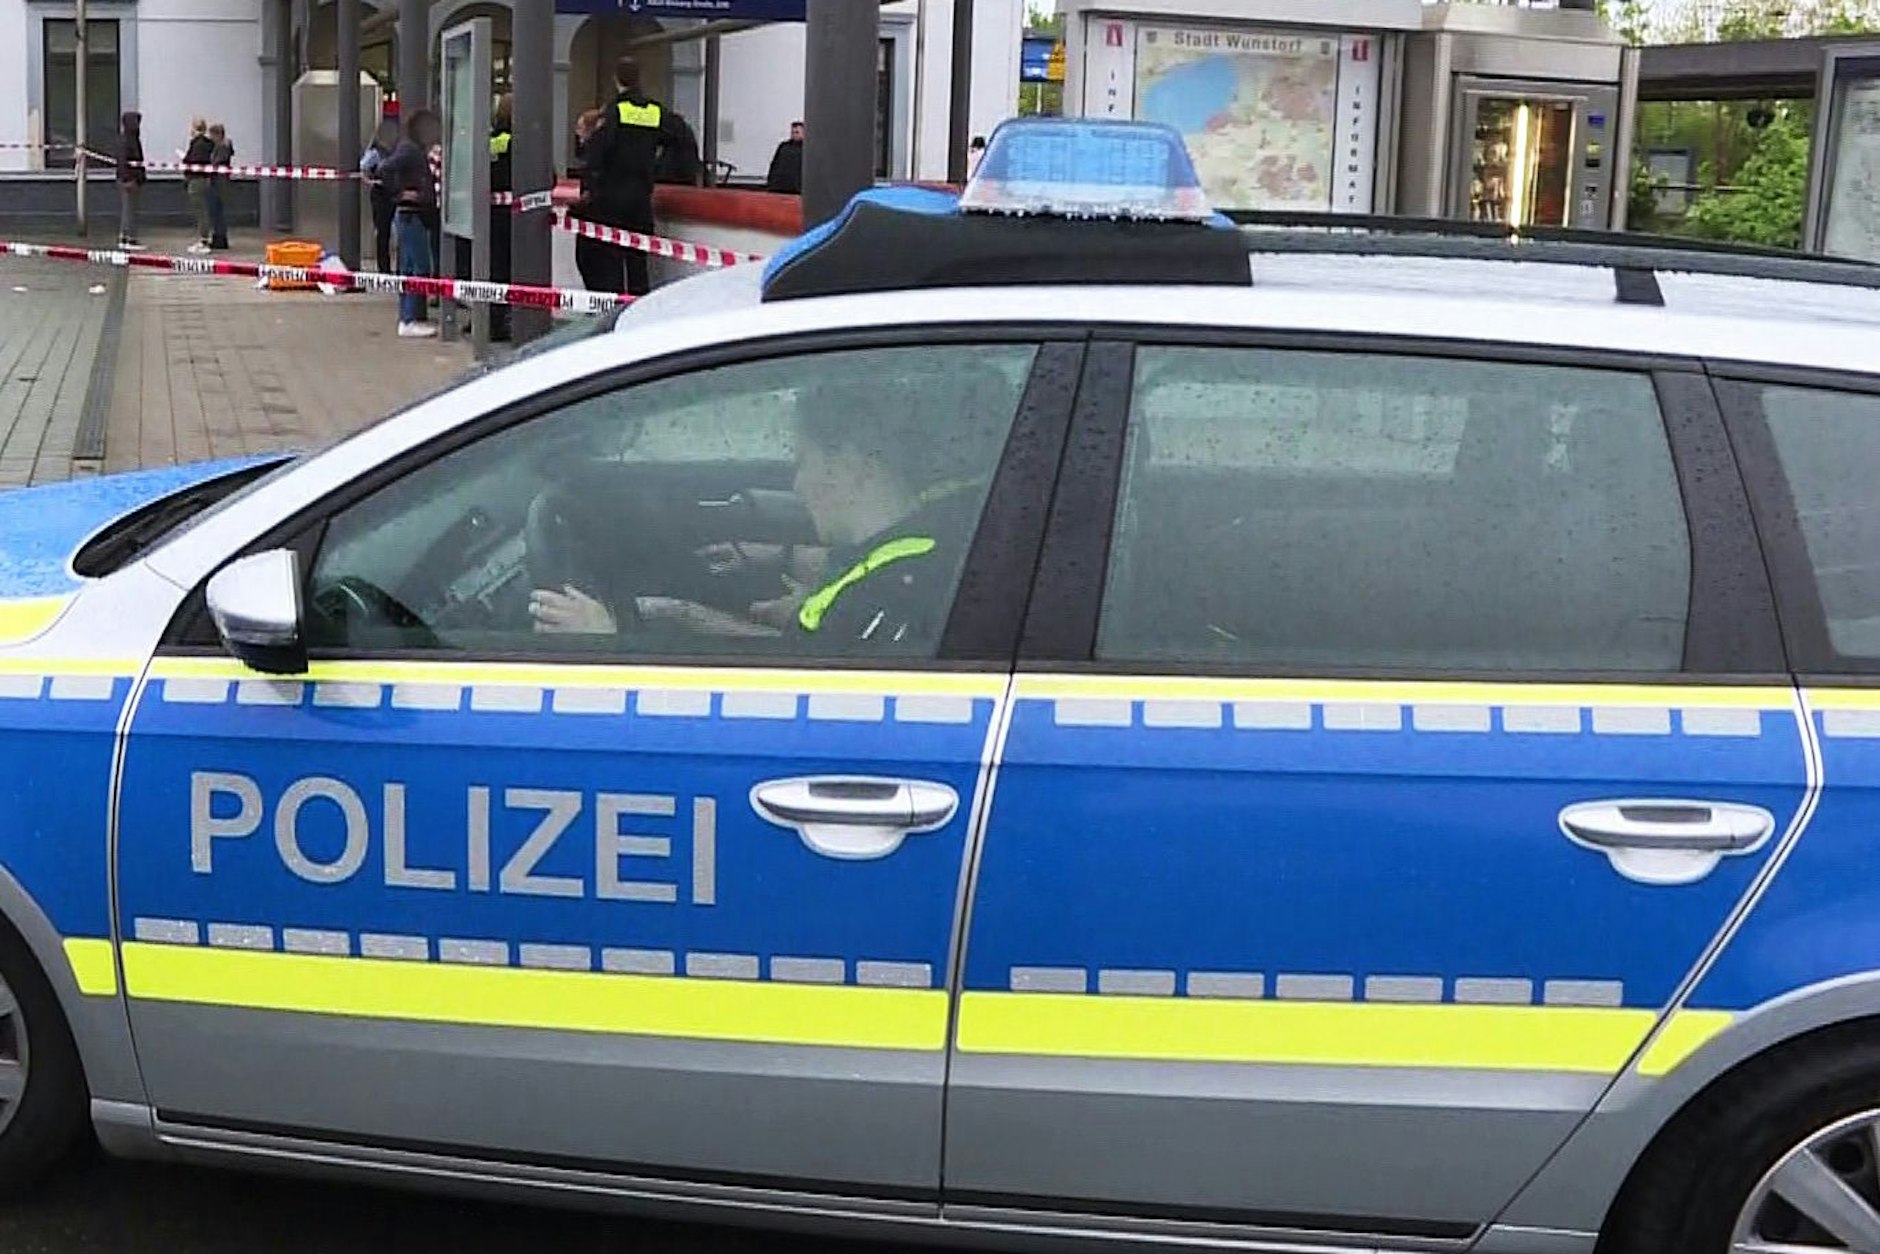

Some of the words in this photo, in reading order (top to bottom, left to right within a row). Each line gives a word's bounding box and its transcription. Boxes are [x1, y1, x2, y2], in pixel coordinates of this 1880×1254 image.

[1174, 31, 1219, 47] Stadt
[1225, 34, 1302, 52] Wunstorf
[190, 771, 717, 905] POLIZEI
